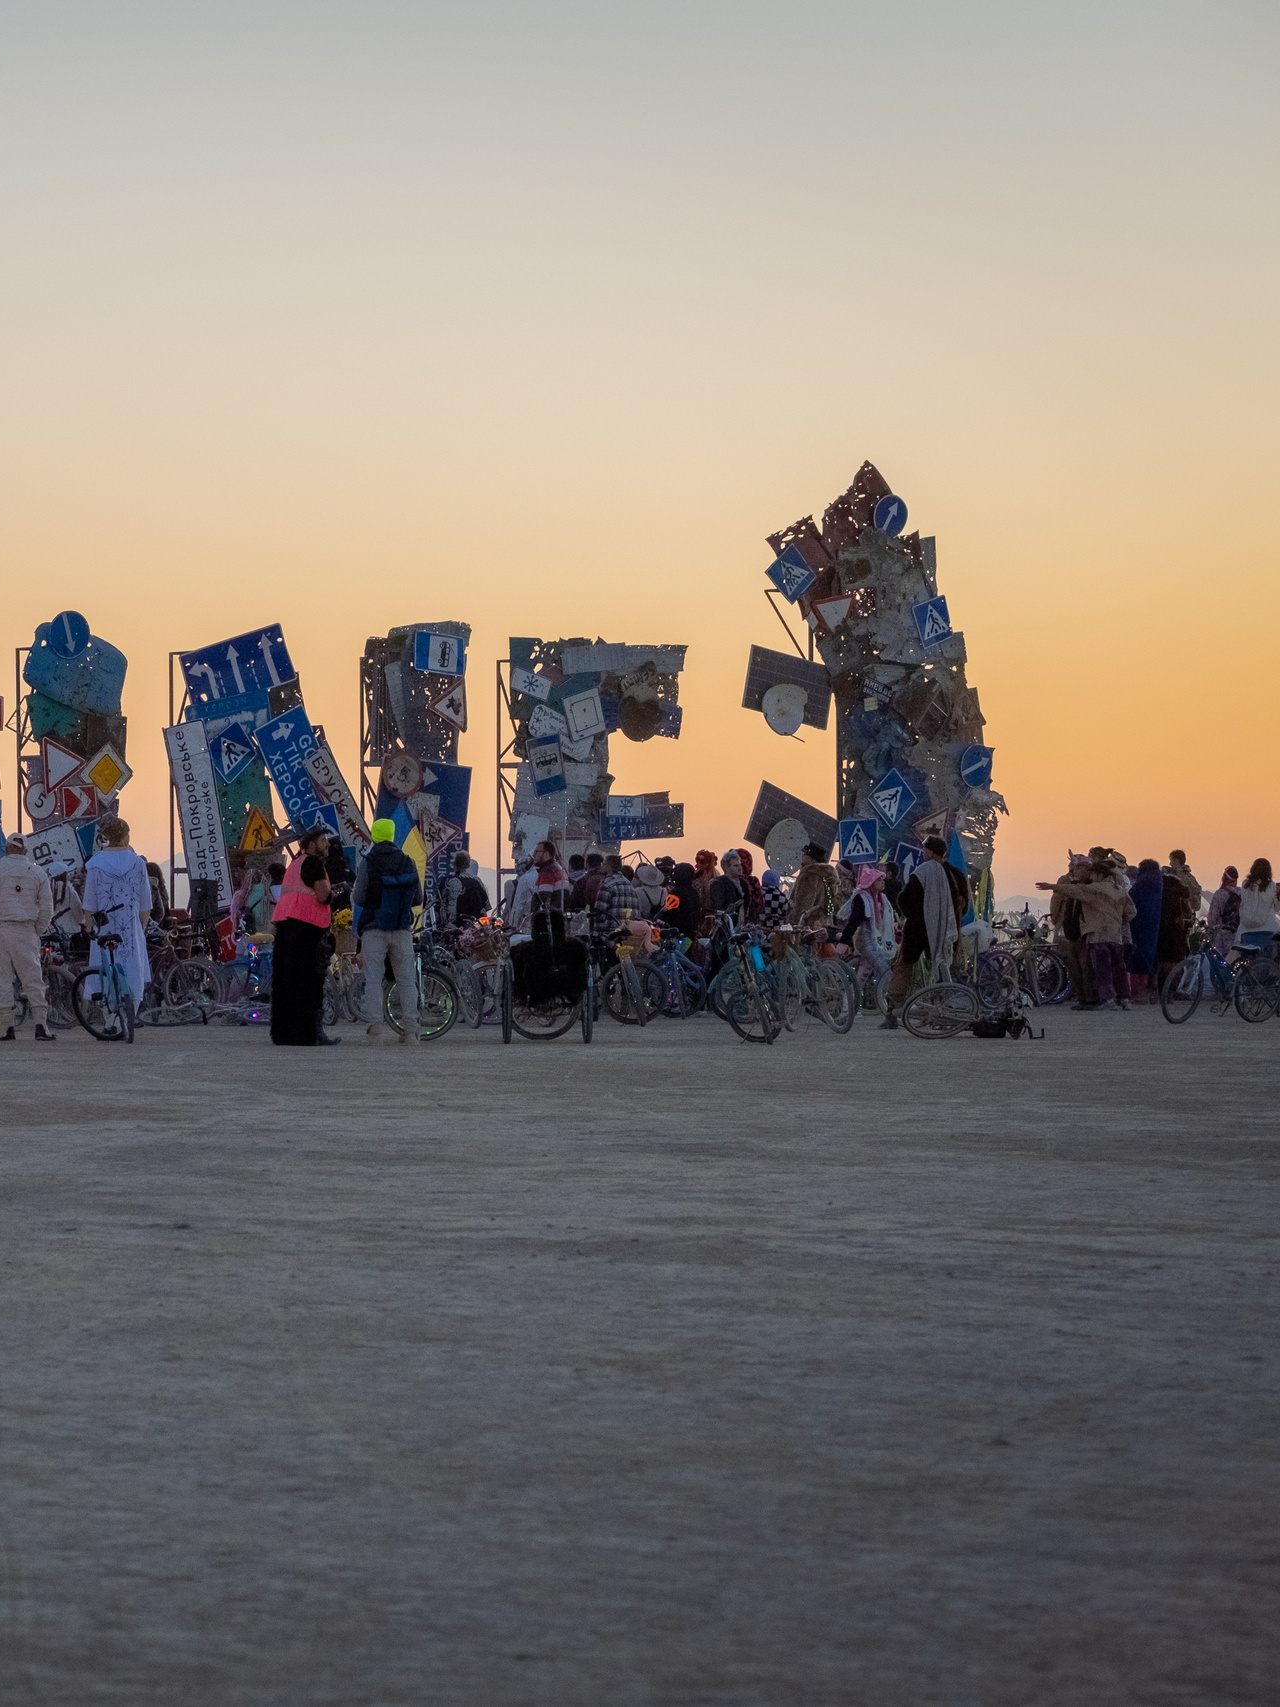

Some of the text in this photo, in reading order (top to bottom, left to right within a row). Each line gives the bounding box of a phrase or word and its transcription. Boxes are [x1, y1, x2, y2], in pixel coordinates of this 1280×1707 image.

[34, 792, 47, 809] 5
[175, 729, 208, 881] сад-Покровське
[268, 755, 303, 816] ХЕРСО
